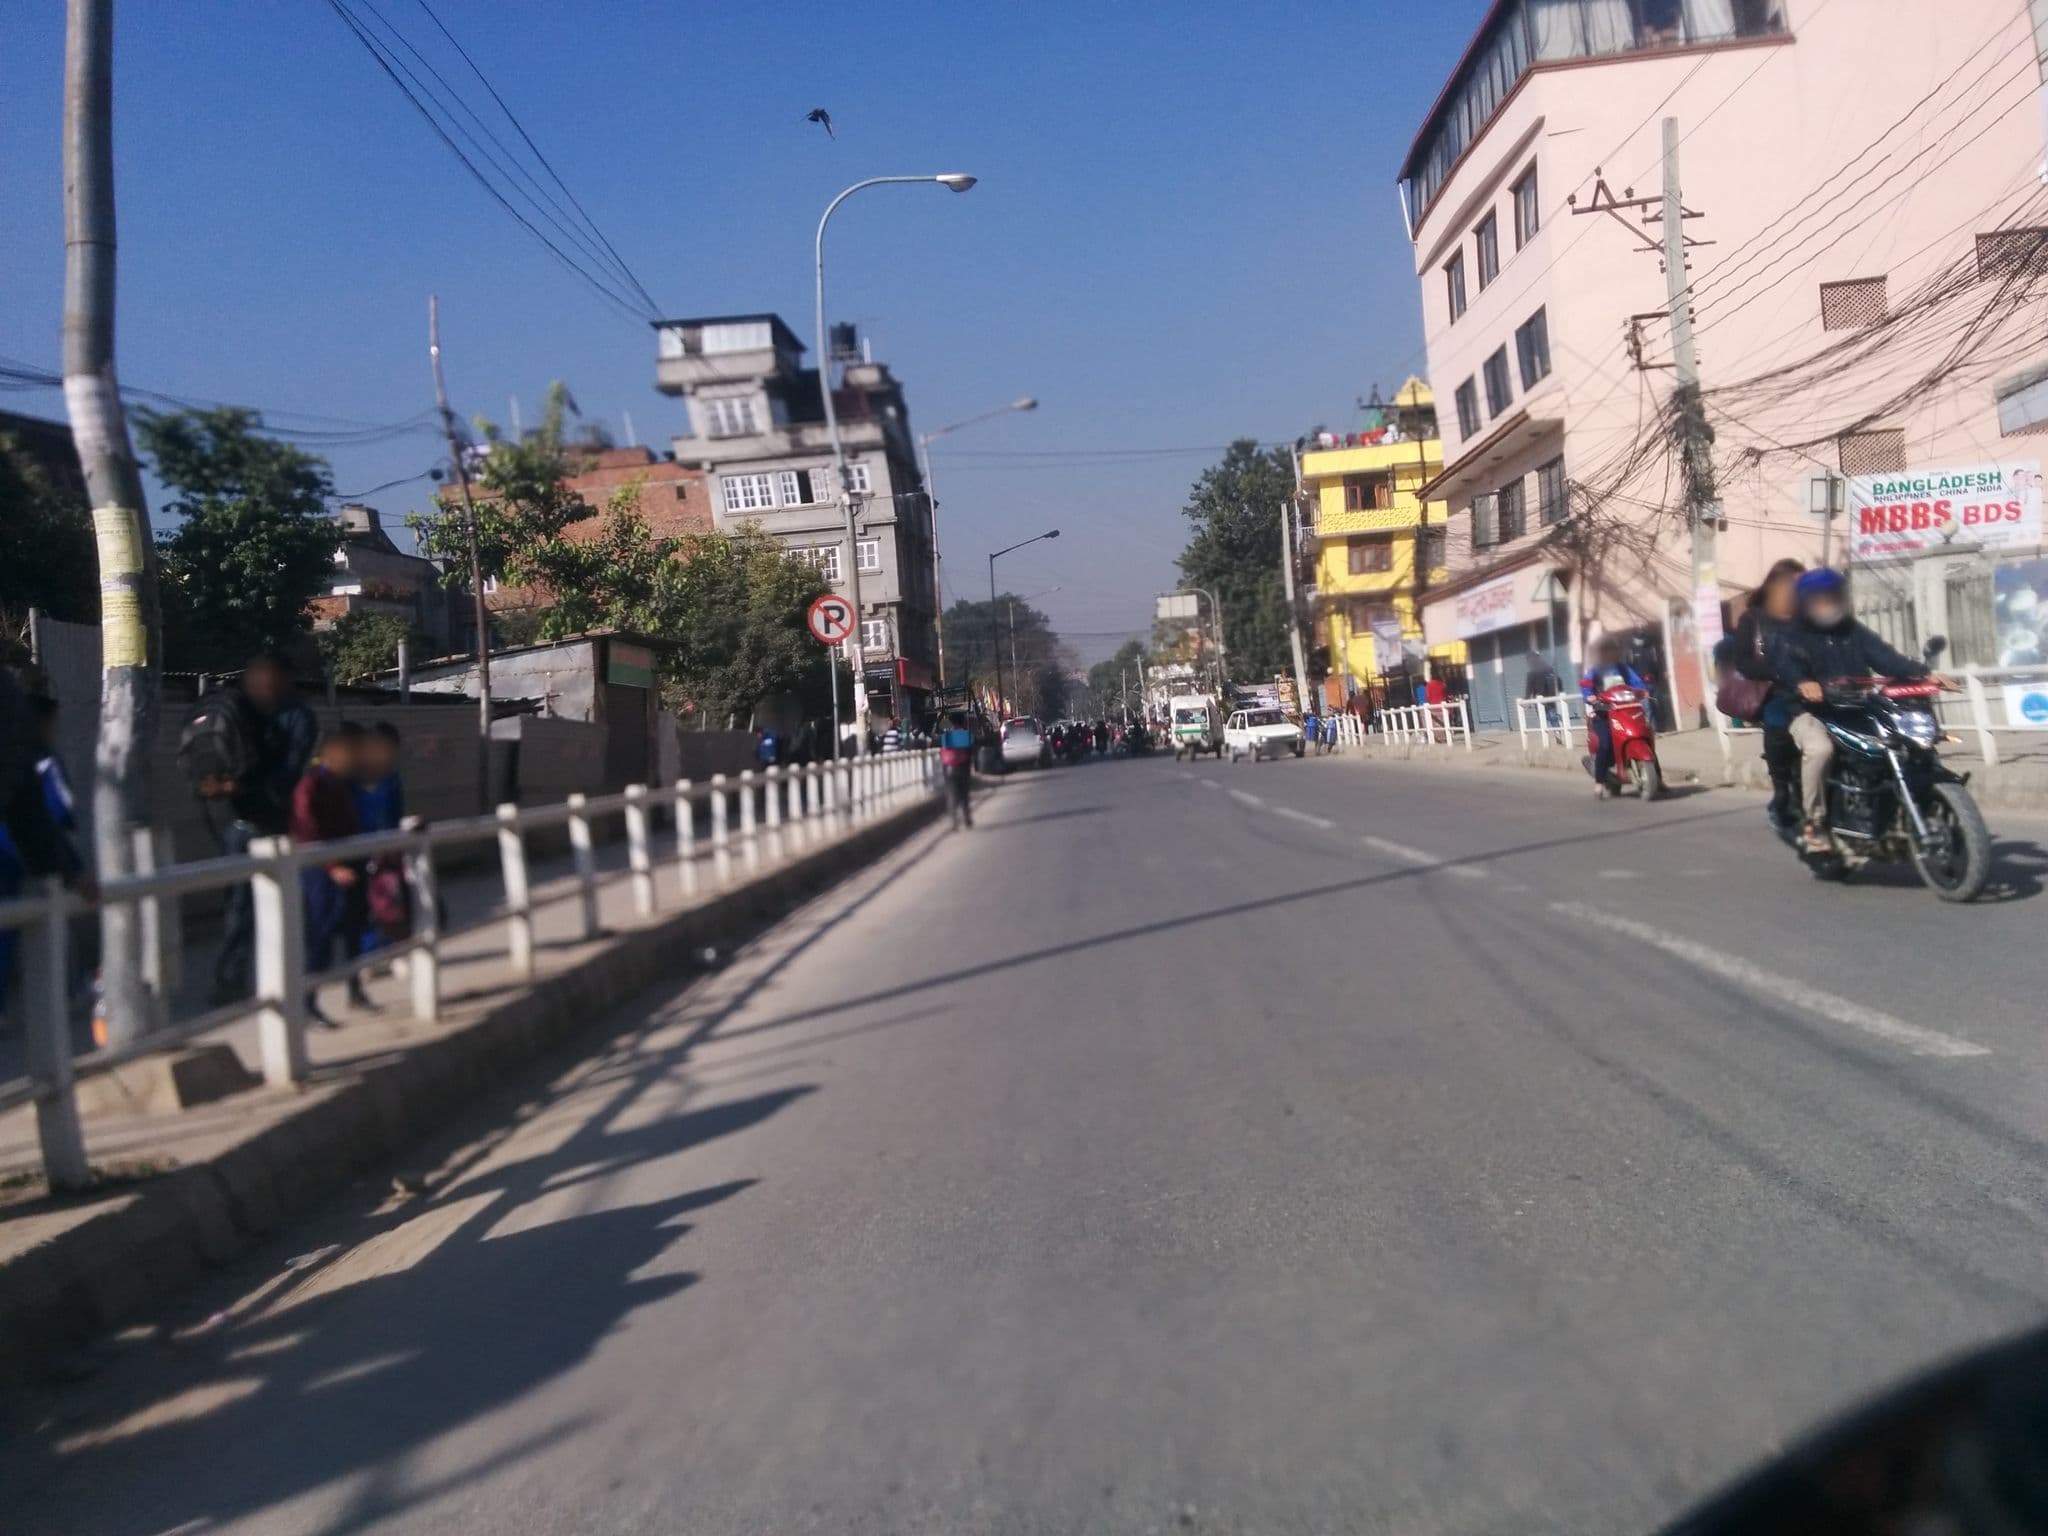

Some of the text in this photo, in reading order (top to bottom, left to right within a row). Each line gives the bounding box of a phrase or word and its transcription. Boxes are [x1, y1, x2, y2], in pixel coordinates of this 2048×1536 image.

[1872, 471, 2002, 496] BANGLADESH
[1873, 484, 2003, 503] PHILIPPINES CHINA INDIA
[1859, 499, 2022, 535] MBBS BDS
[823, 605, 845, 635] P
